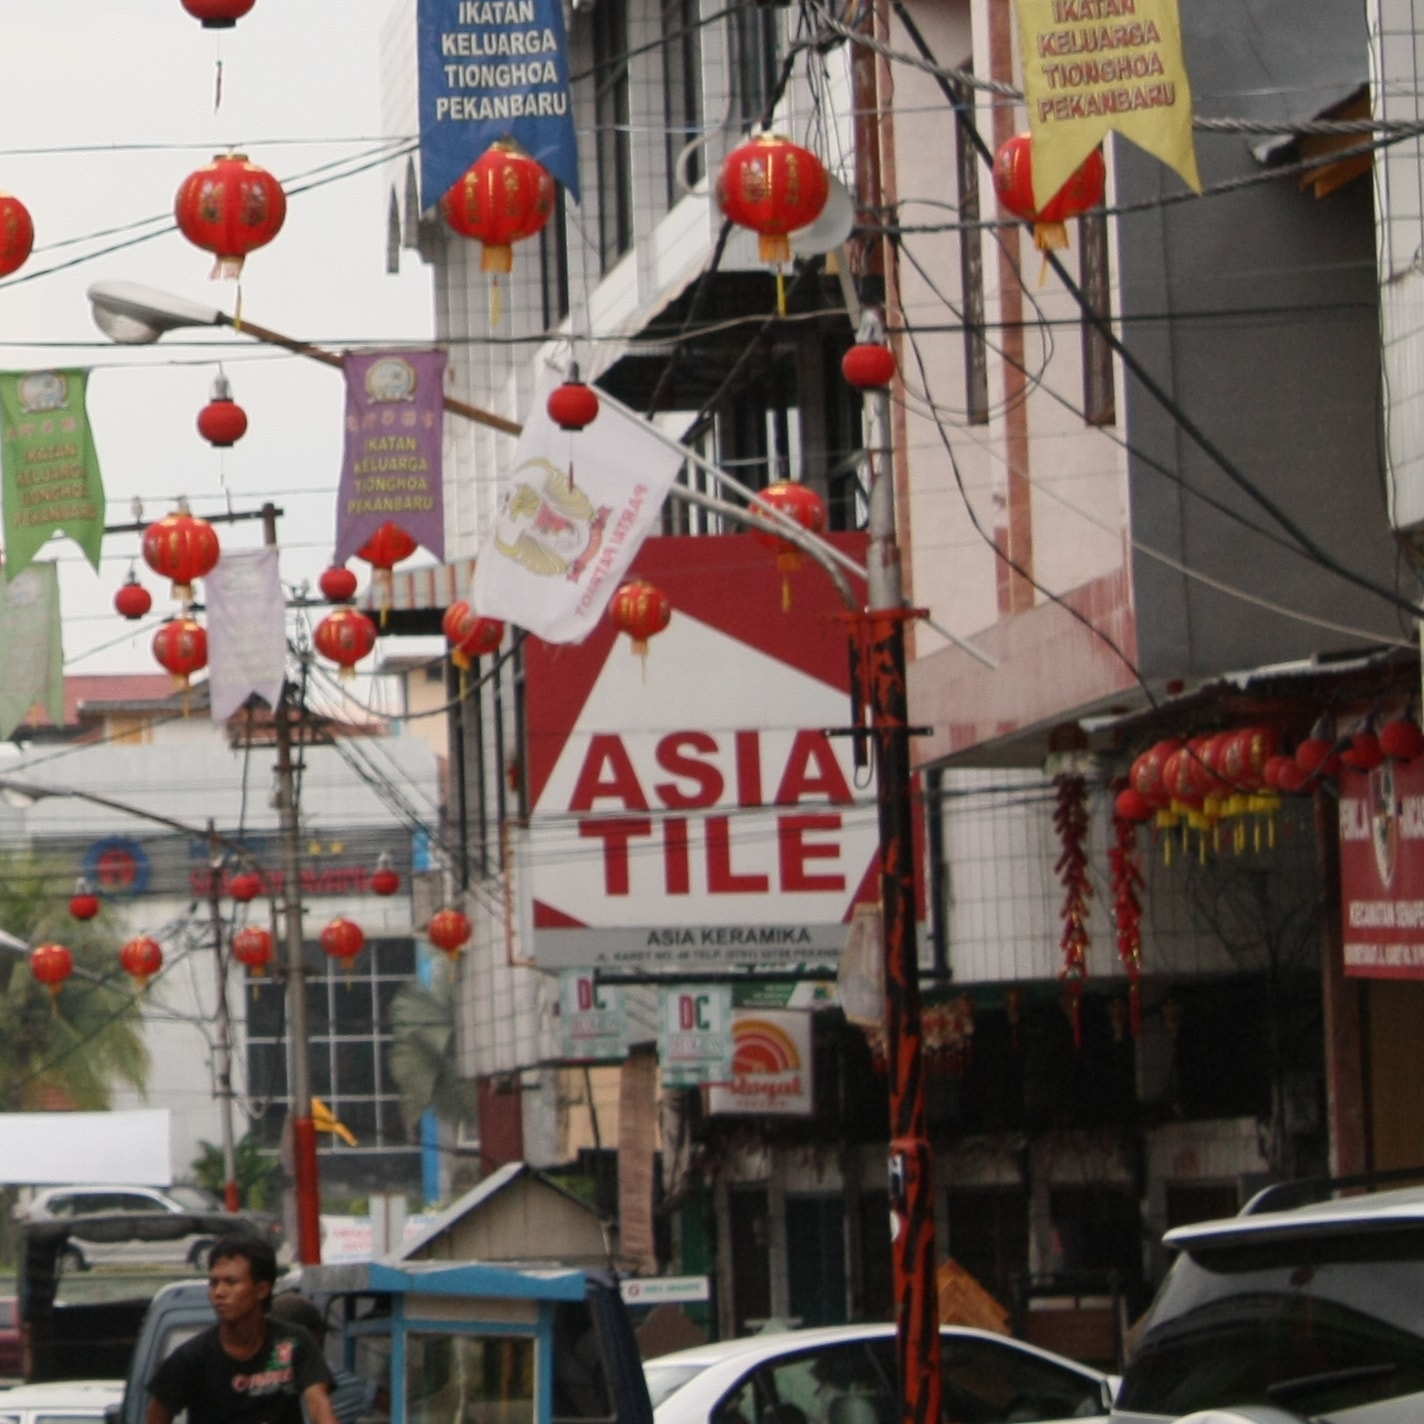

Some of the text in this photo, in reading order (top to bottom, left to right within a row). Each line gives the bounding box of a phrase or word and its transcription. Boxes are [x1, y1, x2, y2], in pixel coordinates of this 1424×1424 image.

[458, 0, 534, 25] IKATAN
[442, 28, 557, 57] KELUARGA
[1038, 20, 1161, 58] KELUARGA
[444, 59, 558, 88] TIONGHOA
[1041, 52, 1164, 89] TIONGHOA
[436, 91, 567, 121] PEKANBARU
[1038, 82, 1176, 122] PEKANBARU
[568, 728, 855, 813] ASIA
[578, 814, 847, 896] TILE
[647, 927, 812, 947] ASIA KERAMIKA
[678, 994, 711, 1030] DC
